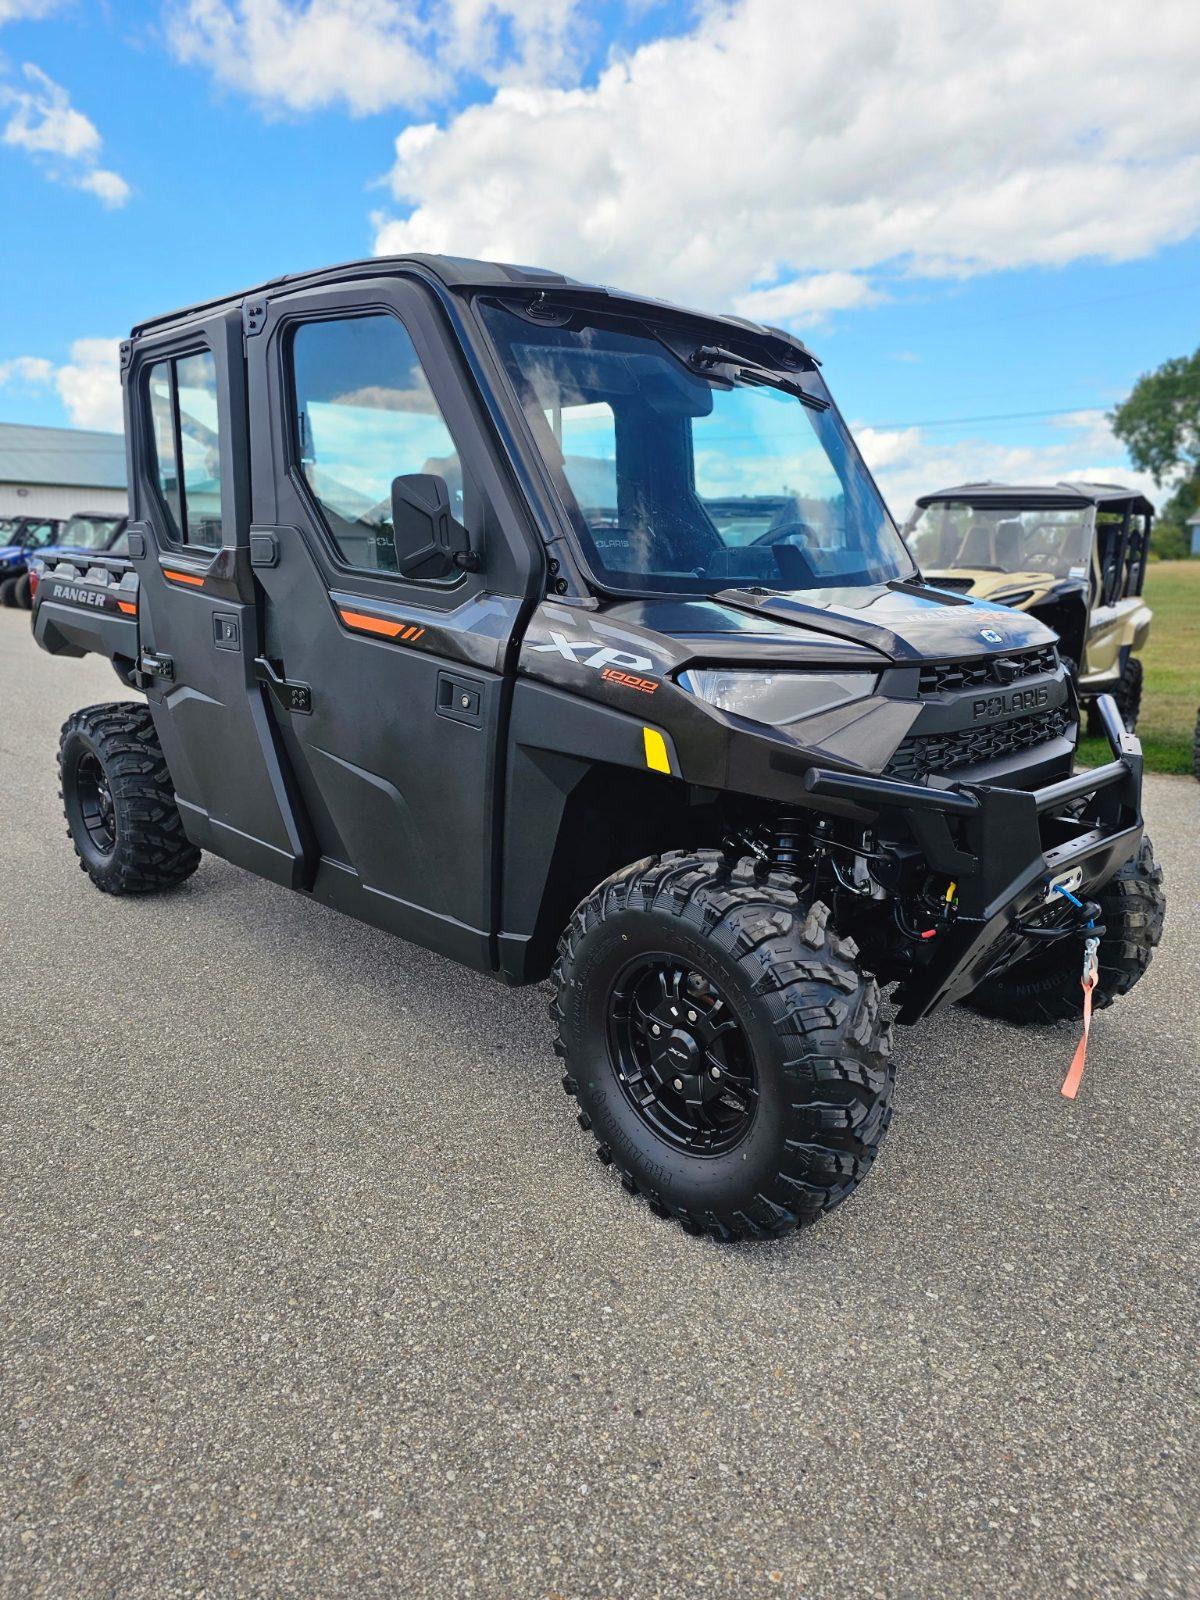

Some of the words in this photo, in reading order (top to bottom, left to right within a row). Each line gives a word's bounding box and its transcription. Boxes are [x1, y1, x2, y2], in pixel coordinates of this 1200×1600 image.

[53, 584, 105, 607] RANGER
[527, 631, 654, 672] XP
[602, 668, 659, 691] 1000
[973, 686, 1048, 721] POLARIS
